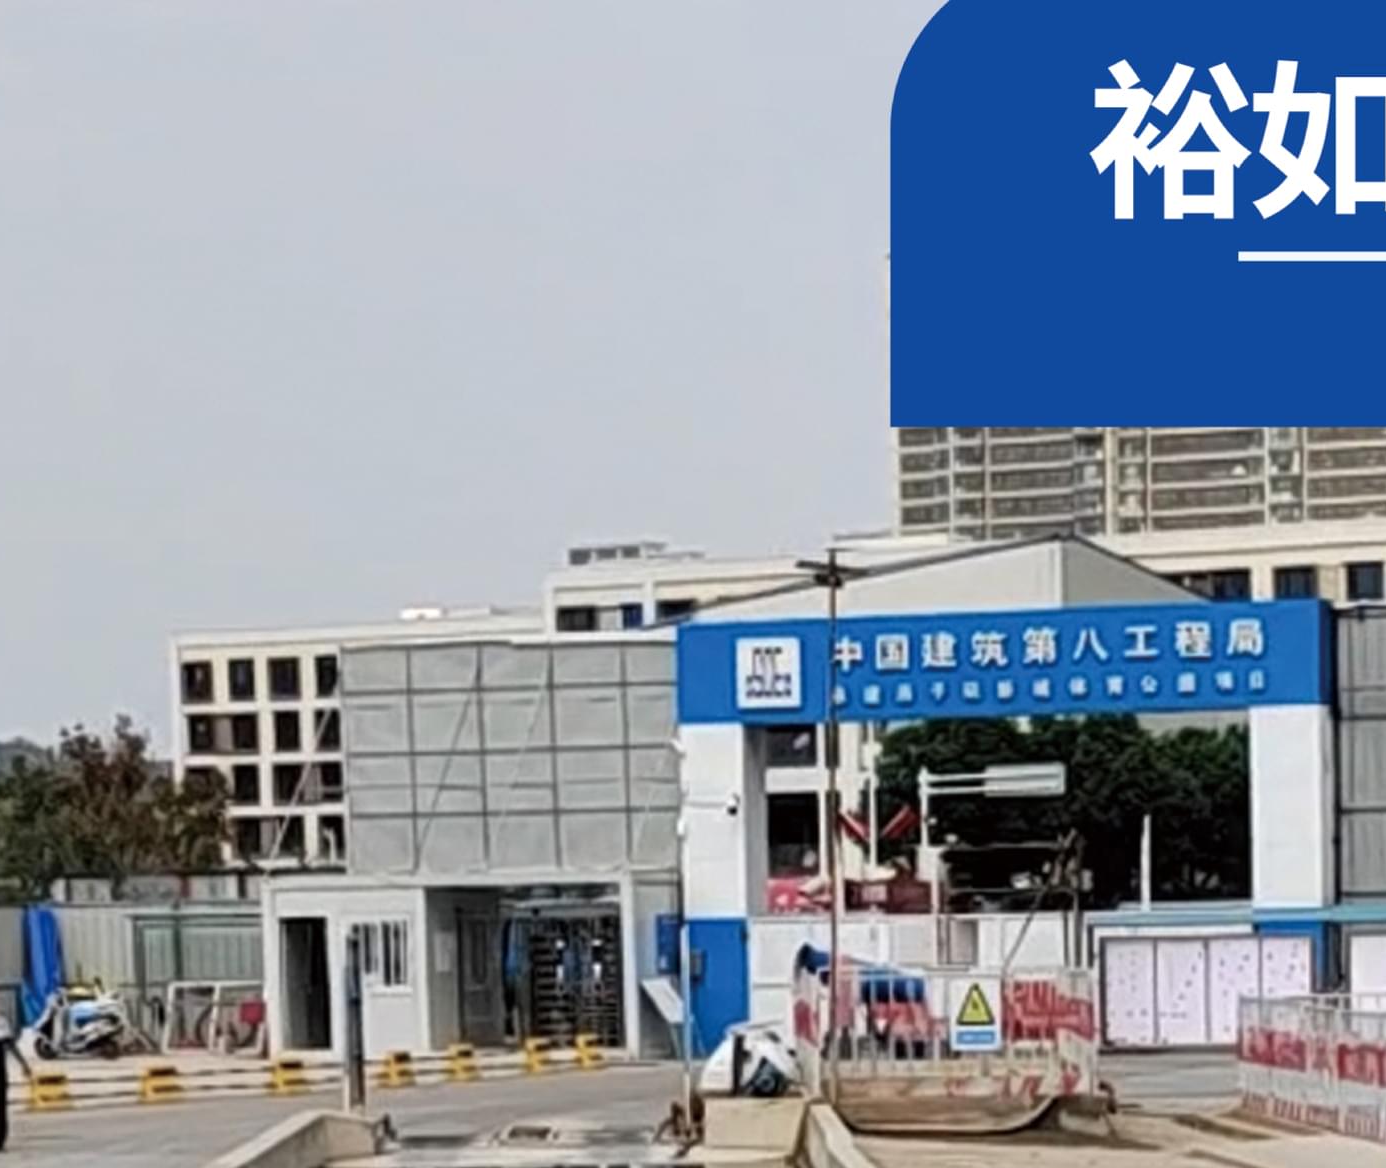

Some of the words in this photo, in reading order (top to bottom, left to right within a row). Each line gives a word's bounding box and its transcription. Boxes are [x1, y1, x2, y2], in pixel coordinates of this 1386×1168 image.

[833, 618, 1264, 672] 中国建筑第八工程局
